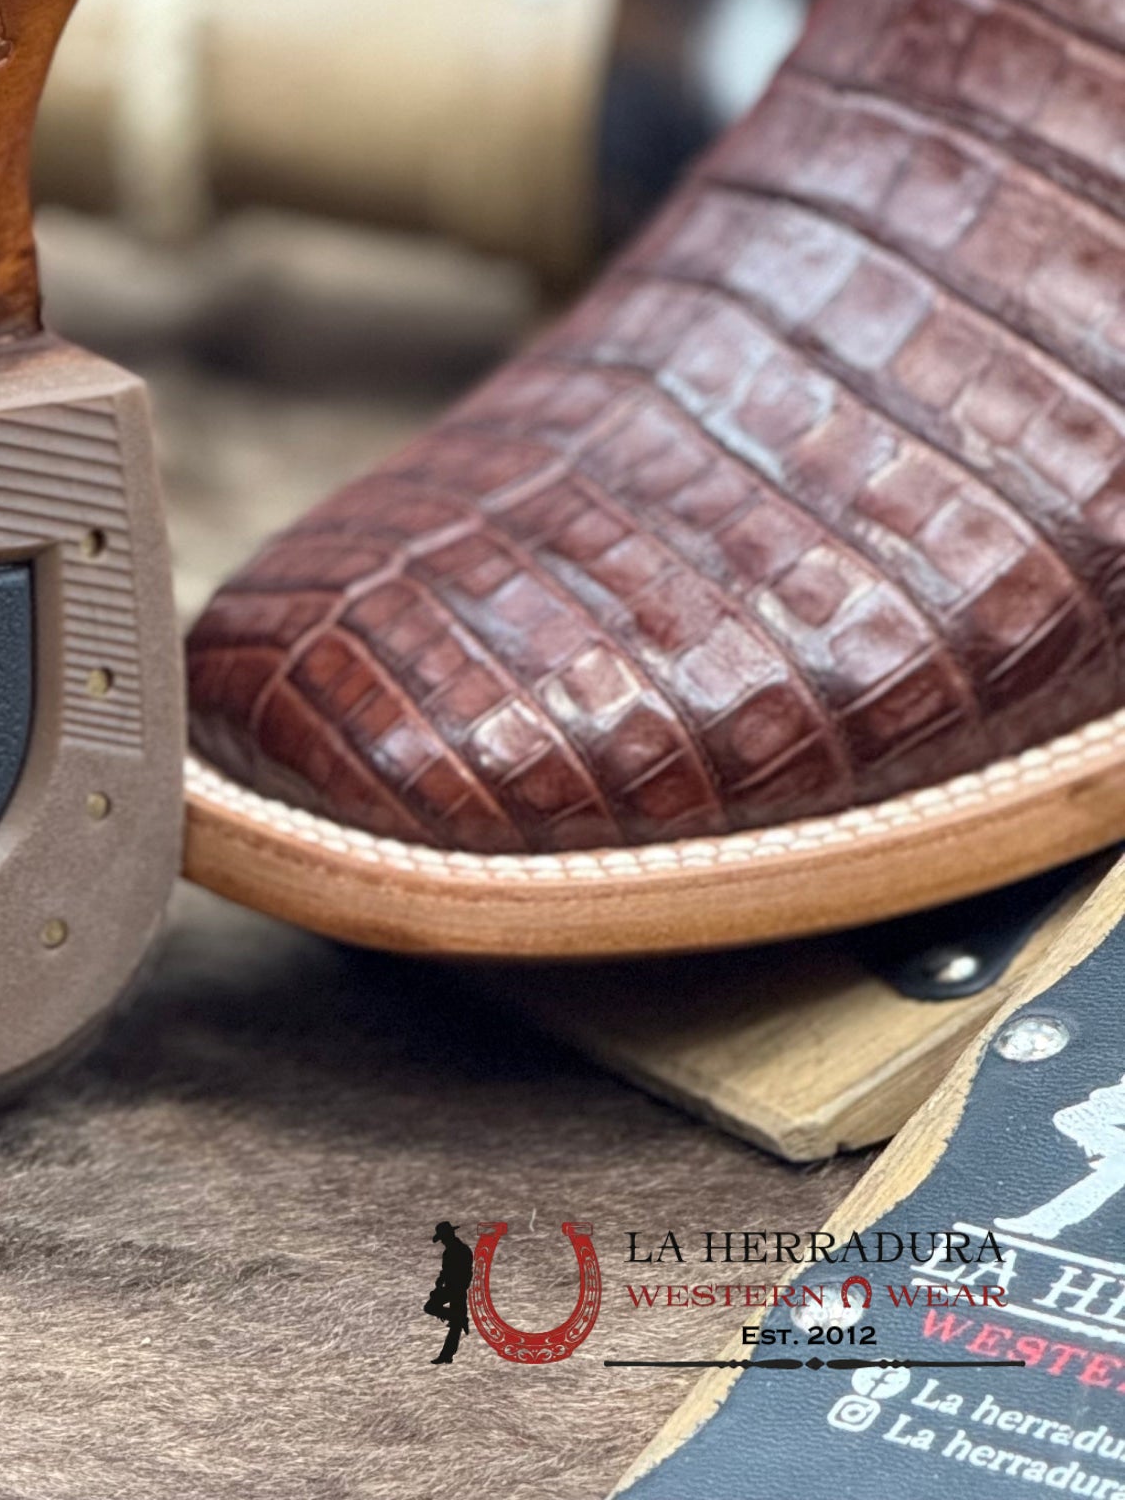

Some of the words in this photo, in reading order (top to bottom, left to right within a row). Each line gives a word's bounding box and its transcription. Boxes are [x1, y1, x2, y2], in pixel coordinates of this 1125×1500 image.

[921, 1308, 1125, 1395] WESTE
[882, 1413, 936, 1451] La
[911, 1378, 964, 1416] La
[971, 1394, 1125, 1463] herradu
